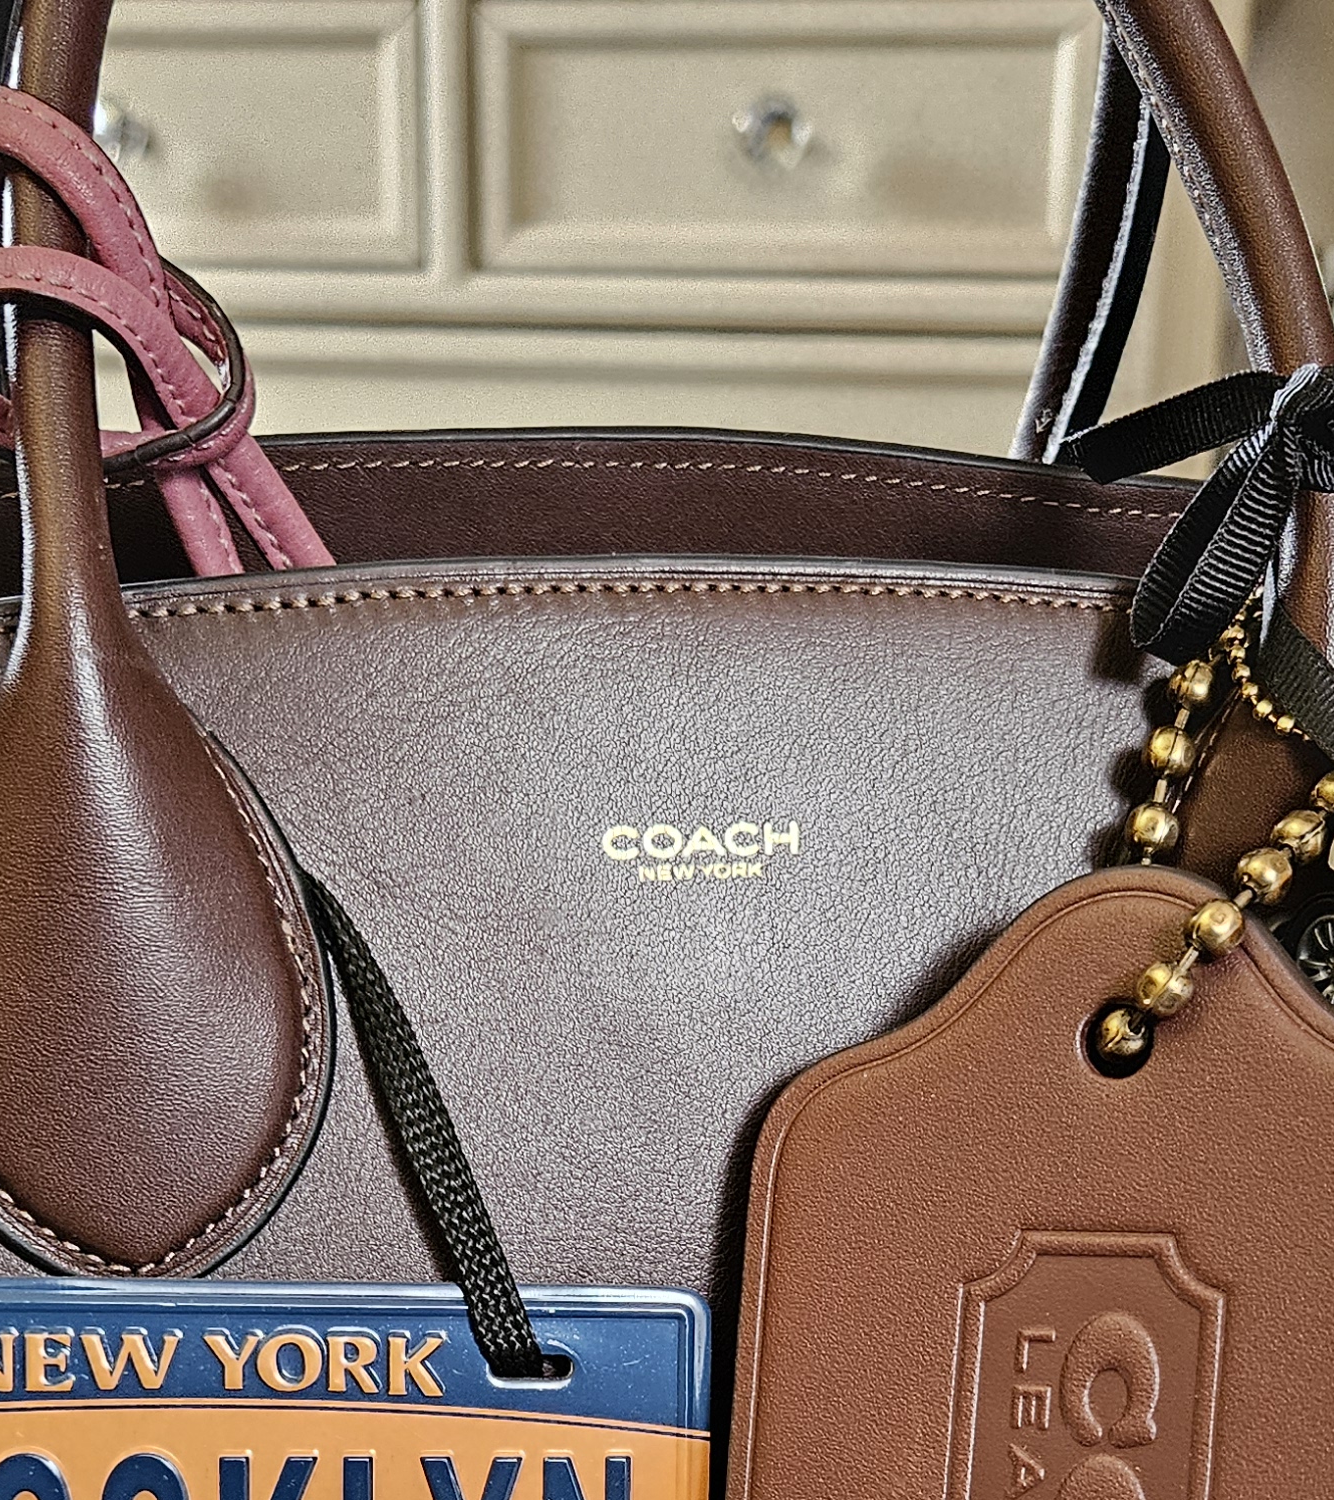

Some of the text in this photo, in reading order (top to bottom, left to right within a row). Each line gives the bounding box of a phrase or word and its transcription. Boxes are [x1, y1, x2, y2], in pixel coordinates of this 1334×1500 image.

[601, 820, 800, 861] COACH
[638, 862, 763, 882] NEW YORK
[203, 1324, 448, 1397] YORK
